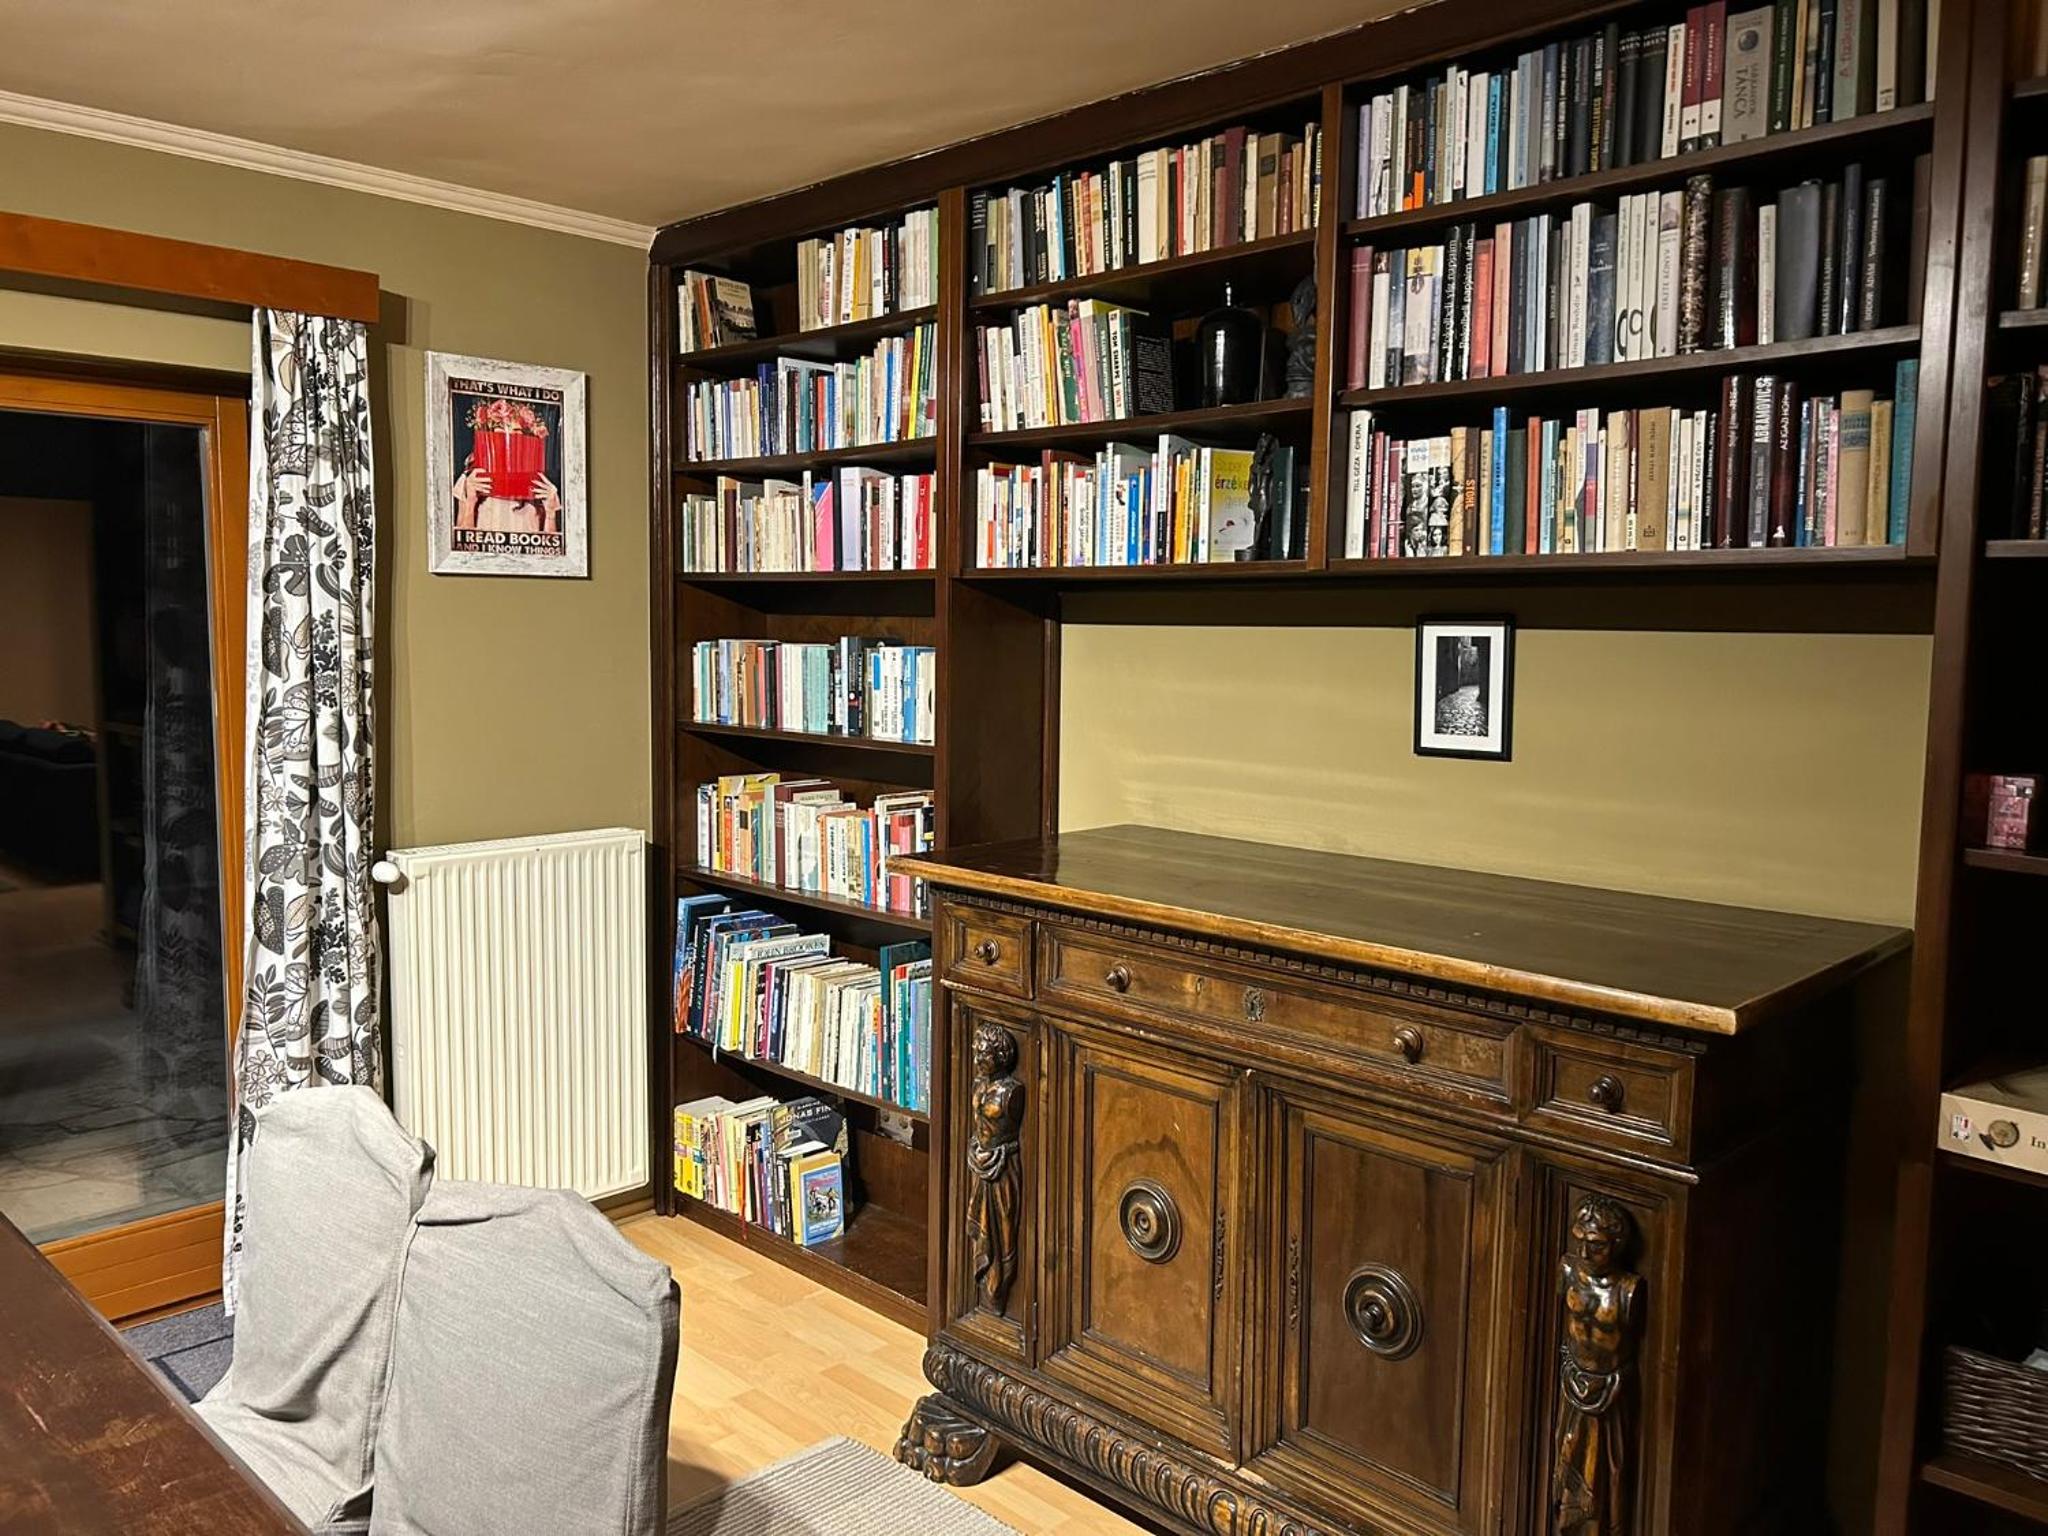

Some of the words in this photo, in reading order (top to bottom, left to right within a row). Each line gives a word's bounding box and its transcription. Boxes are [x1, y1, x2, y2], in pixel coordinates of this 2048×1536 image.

[1442, 302, 1454, 349] Pokolbeli
[1448, 239, 1458, 280] napjaim
[1463, 262, 1474, 303] napjaim
[1459, 304, 1470, 349] Pokolbeli
[453, 380, 494, 393] THAT'S
[497, 383, 532, 398] WHAT
[543, 389, 560, 401] DO
[455, 542, 480, 552] AND
[488, 544, 522, 554] KNOW
[525, 547, 562, 556] THINGS
[456, 531, 461, 542] I
[465, 531, 506, 544] READ
[510, 533, 560, 547] BOOKS
